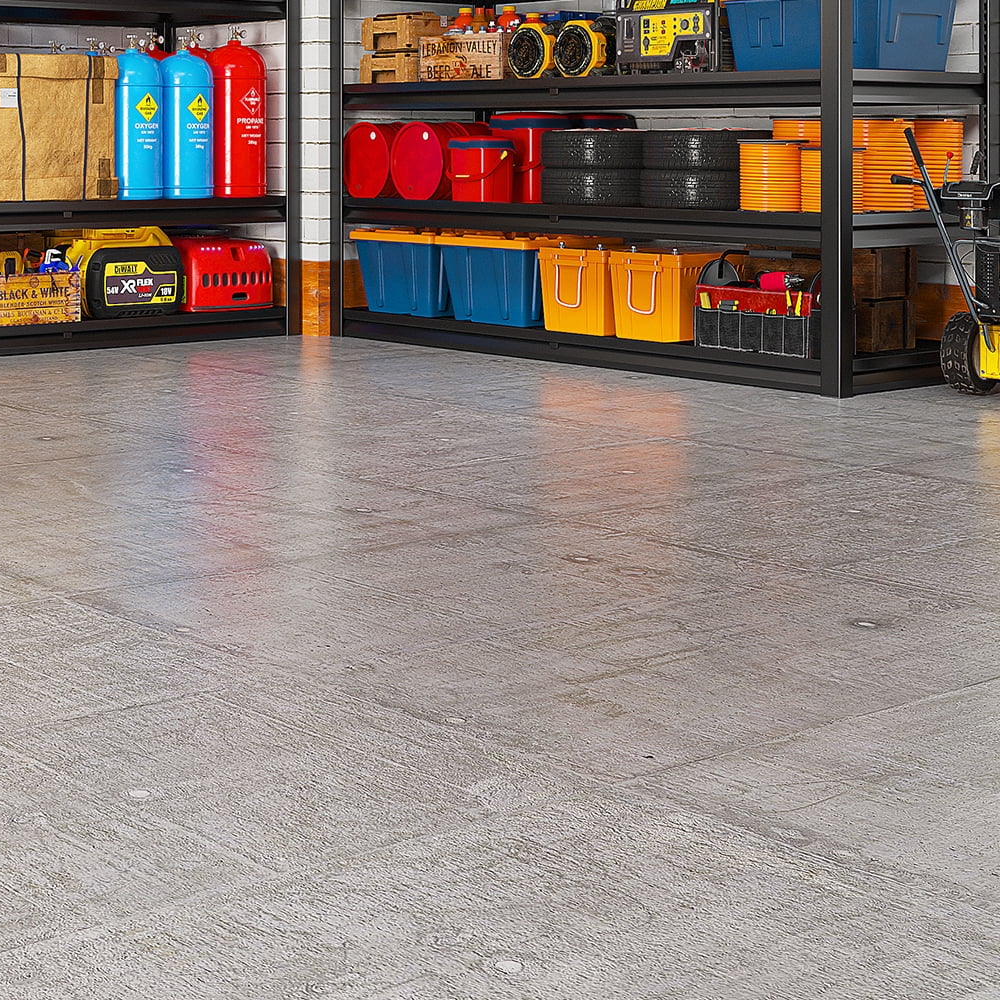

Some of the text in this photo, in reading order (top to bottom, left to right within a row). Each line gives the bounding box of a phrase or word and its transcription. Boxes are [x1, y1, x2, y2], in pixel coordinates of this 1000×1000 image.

[422, 40, 497, 58] LEBANON VALLEY
[427, 64, 492, 79] BEER ALE
[31, 290, 38, 299] &
[40, 286, 69, 298] WHITE
[106, 286, 119, 295] 54V
[120, 279, 137, 294] XR
[137, 278, 153, 286] FLEX
[160, 287, 172, 296] 18V
